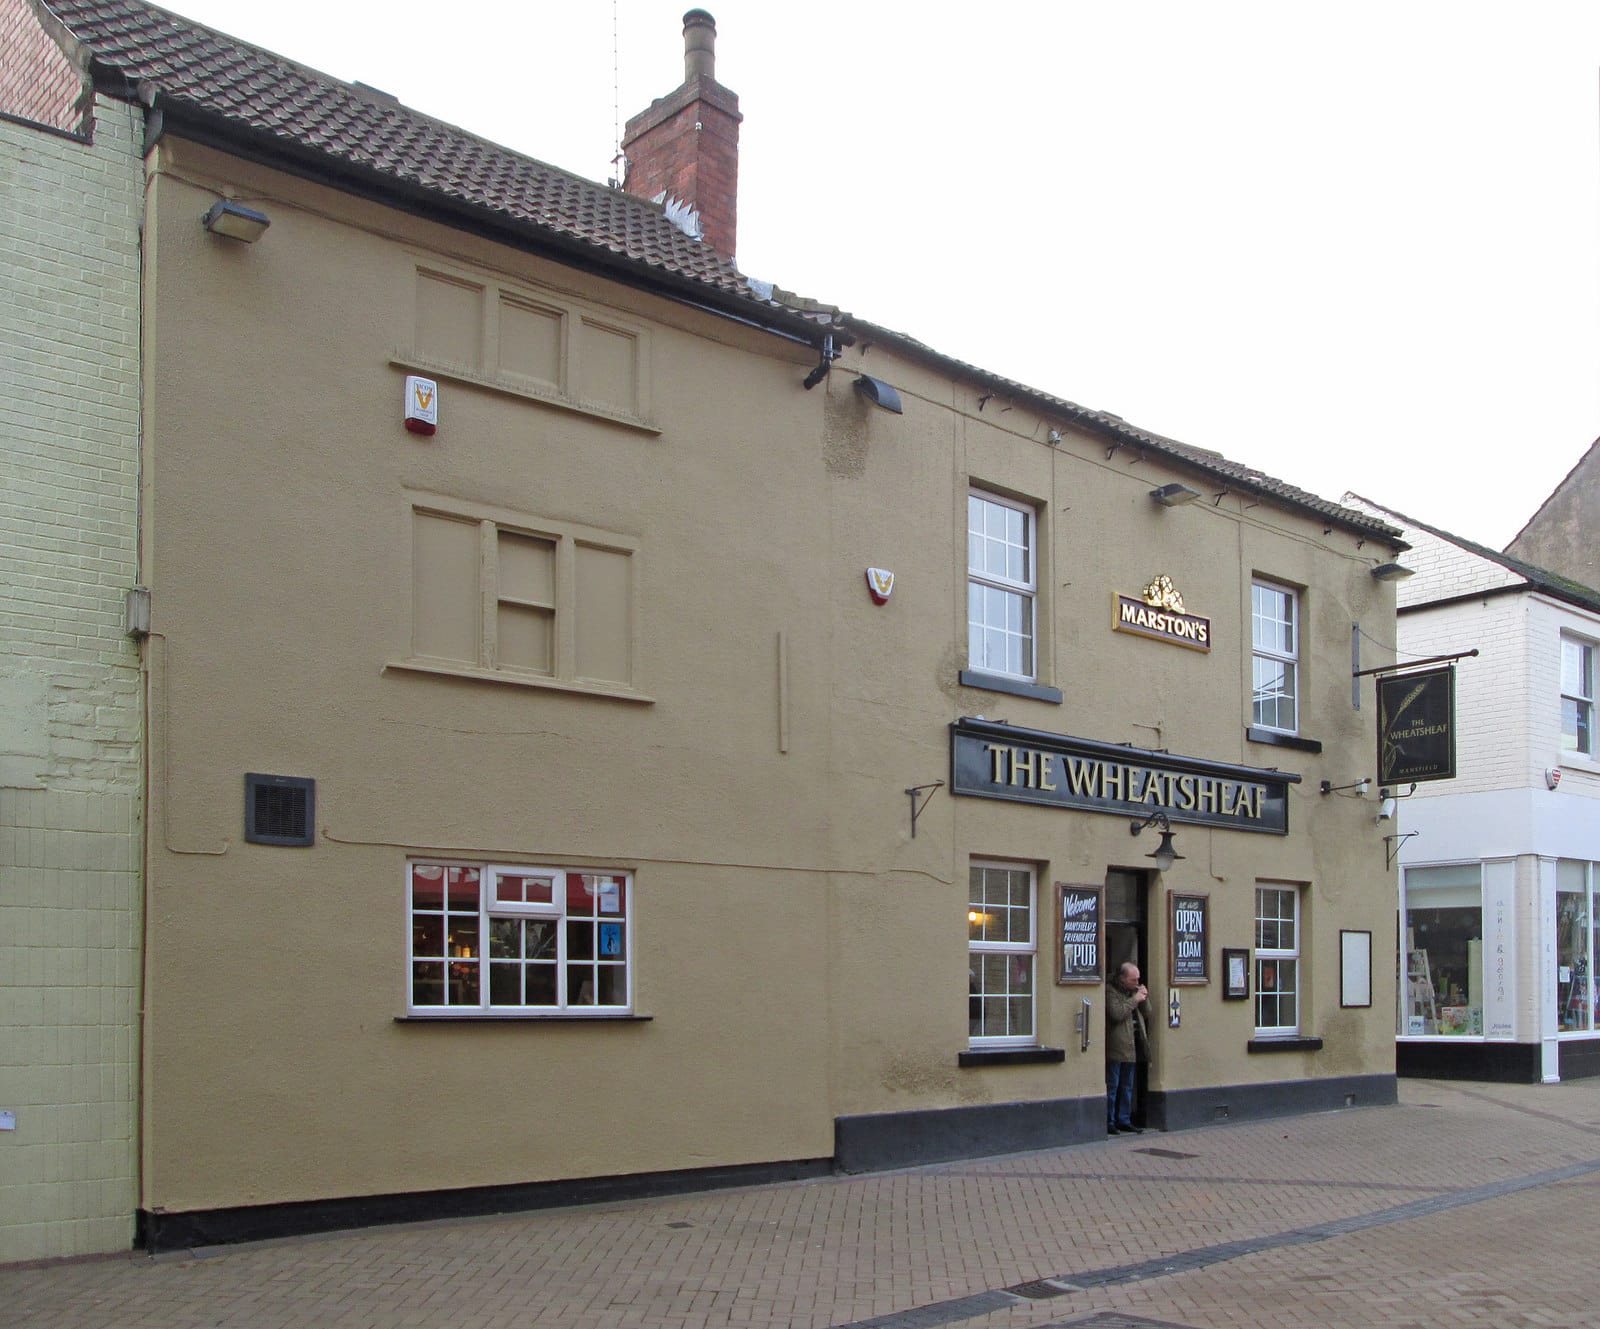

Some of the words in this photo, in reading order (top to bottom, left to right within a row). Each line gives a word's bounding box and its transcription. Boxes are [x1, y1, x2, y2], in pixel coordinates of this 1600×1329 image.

[1121, 603, 1207, 641] MARSTON'S
[1390, 724, 1448, 740] WHEATSHEAF
[986, 744, 1057, 791] THE
[1066, 757, 1267, 819] WHEATSHEAF
[1064, 893, 1097, 918] Welcome
[1176, 909, 1203, 933] OPEN
[1073, 943, 1097, 967] PUB
[1178, 941, 1201, 958] 10AM
